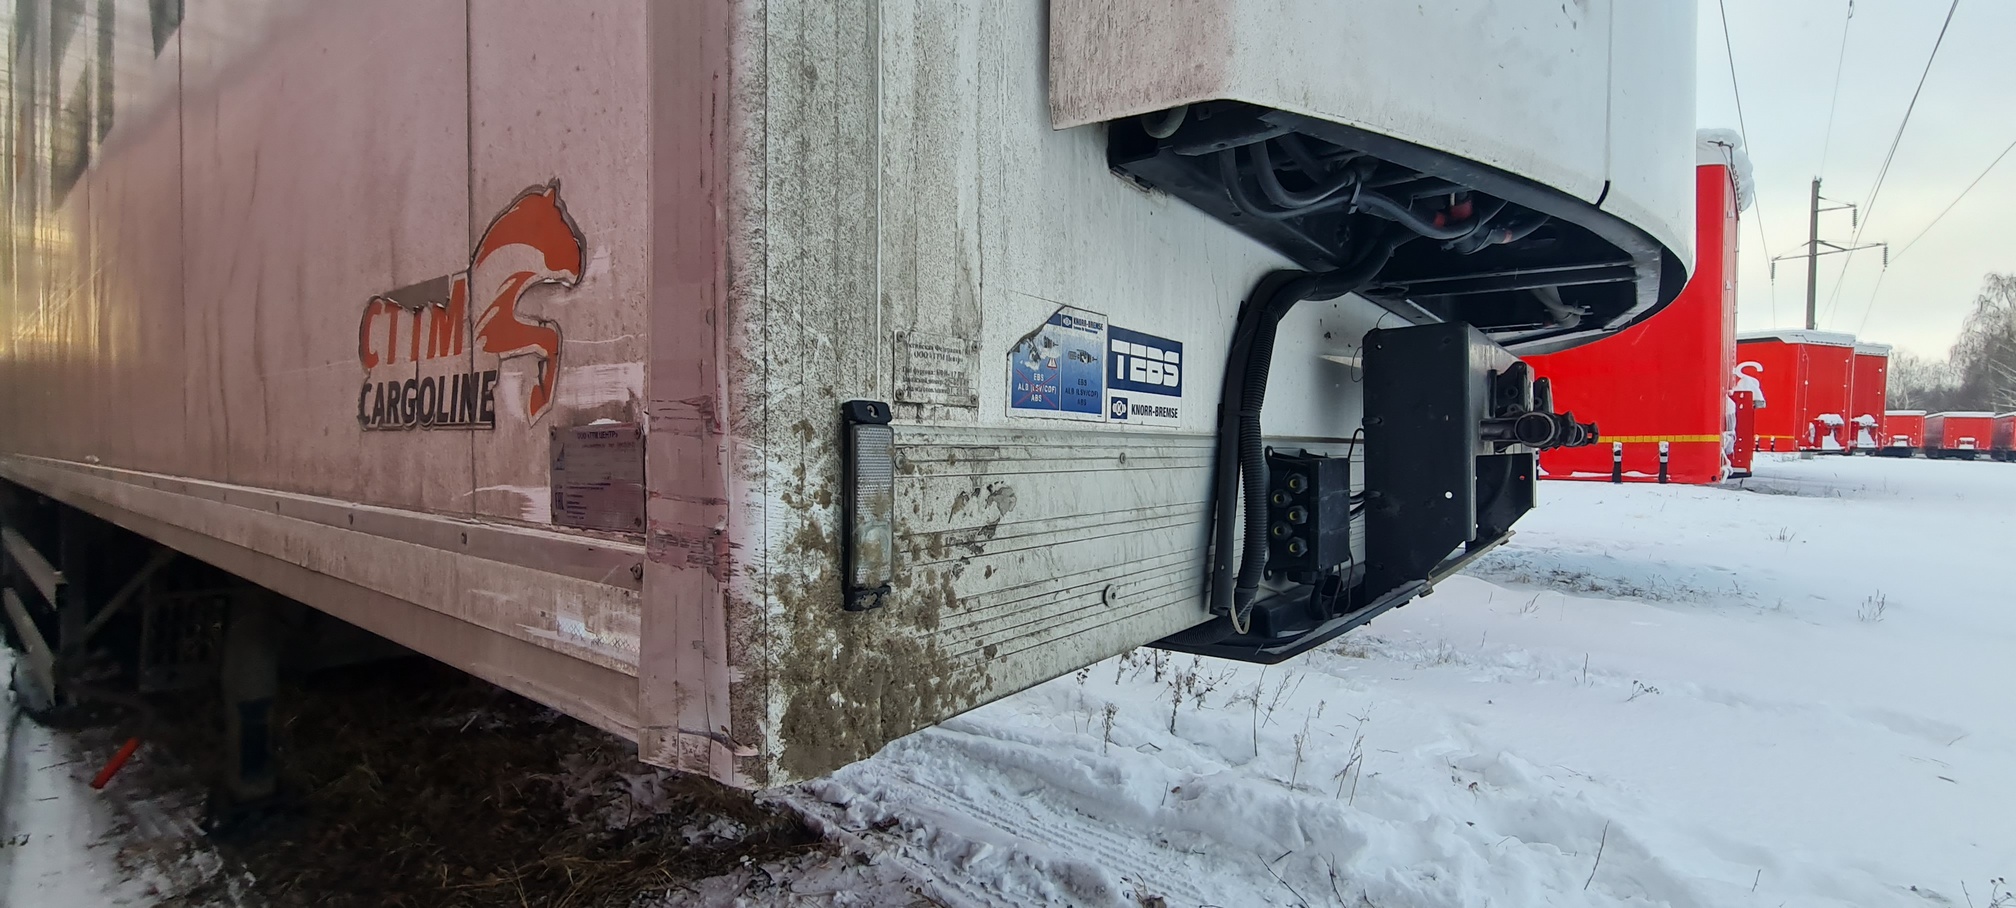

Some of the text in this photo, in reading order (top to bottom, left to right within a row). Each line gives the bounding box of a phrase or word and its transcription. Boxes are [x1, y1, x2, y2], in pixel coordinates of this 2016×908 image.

[1073, 317, 1104, 331] KNORR-BREMSE
[1111, 338, 1180, 388] TEBS
[1033, 372, 1044, 382] EBS
[1078, 378, 1087, 386] EBS
[1017, 382, 1029, 391] ALB
[359, 370, 497, 424] CARGOLINE
[1030, 394, 1042, 402] ABS
[1131, 403, 1178, 419] KNORR-BREMSE
